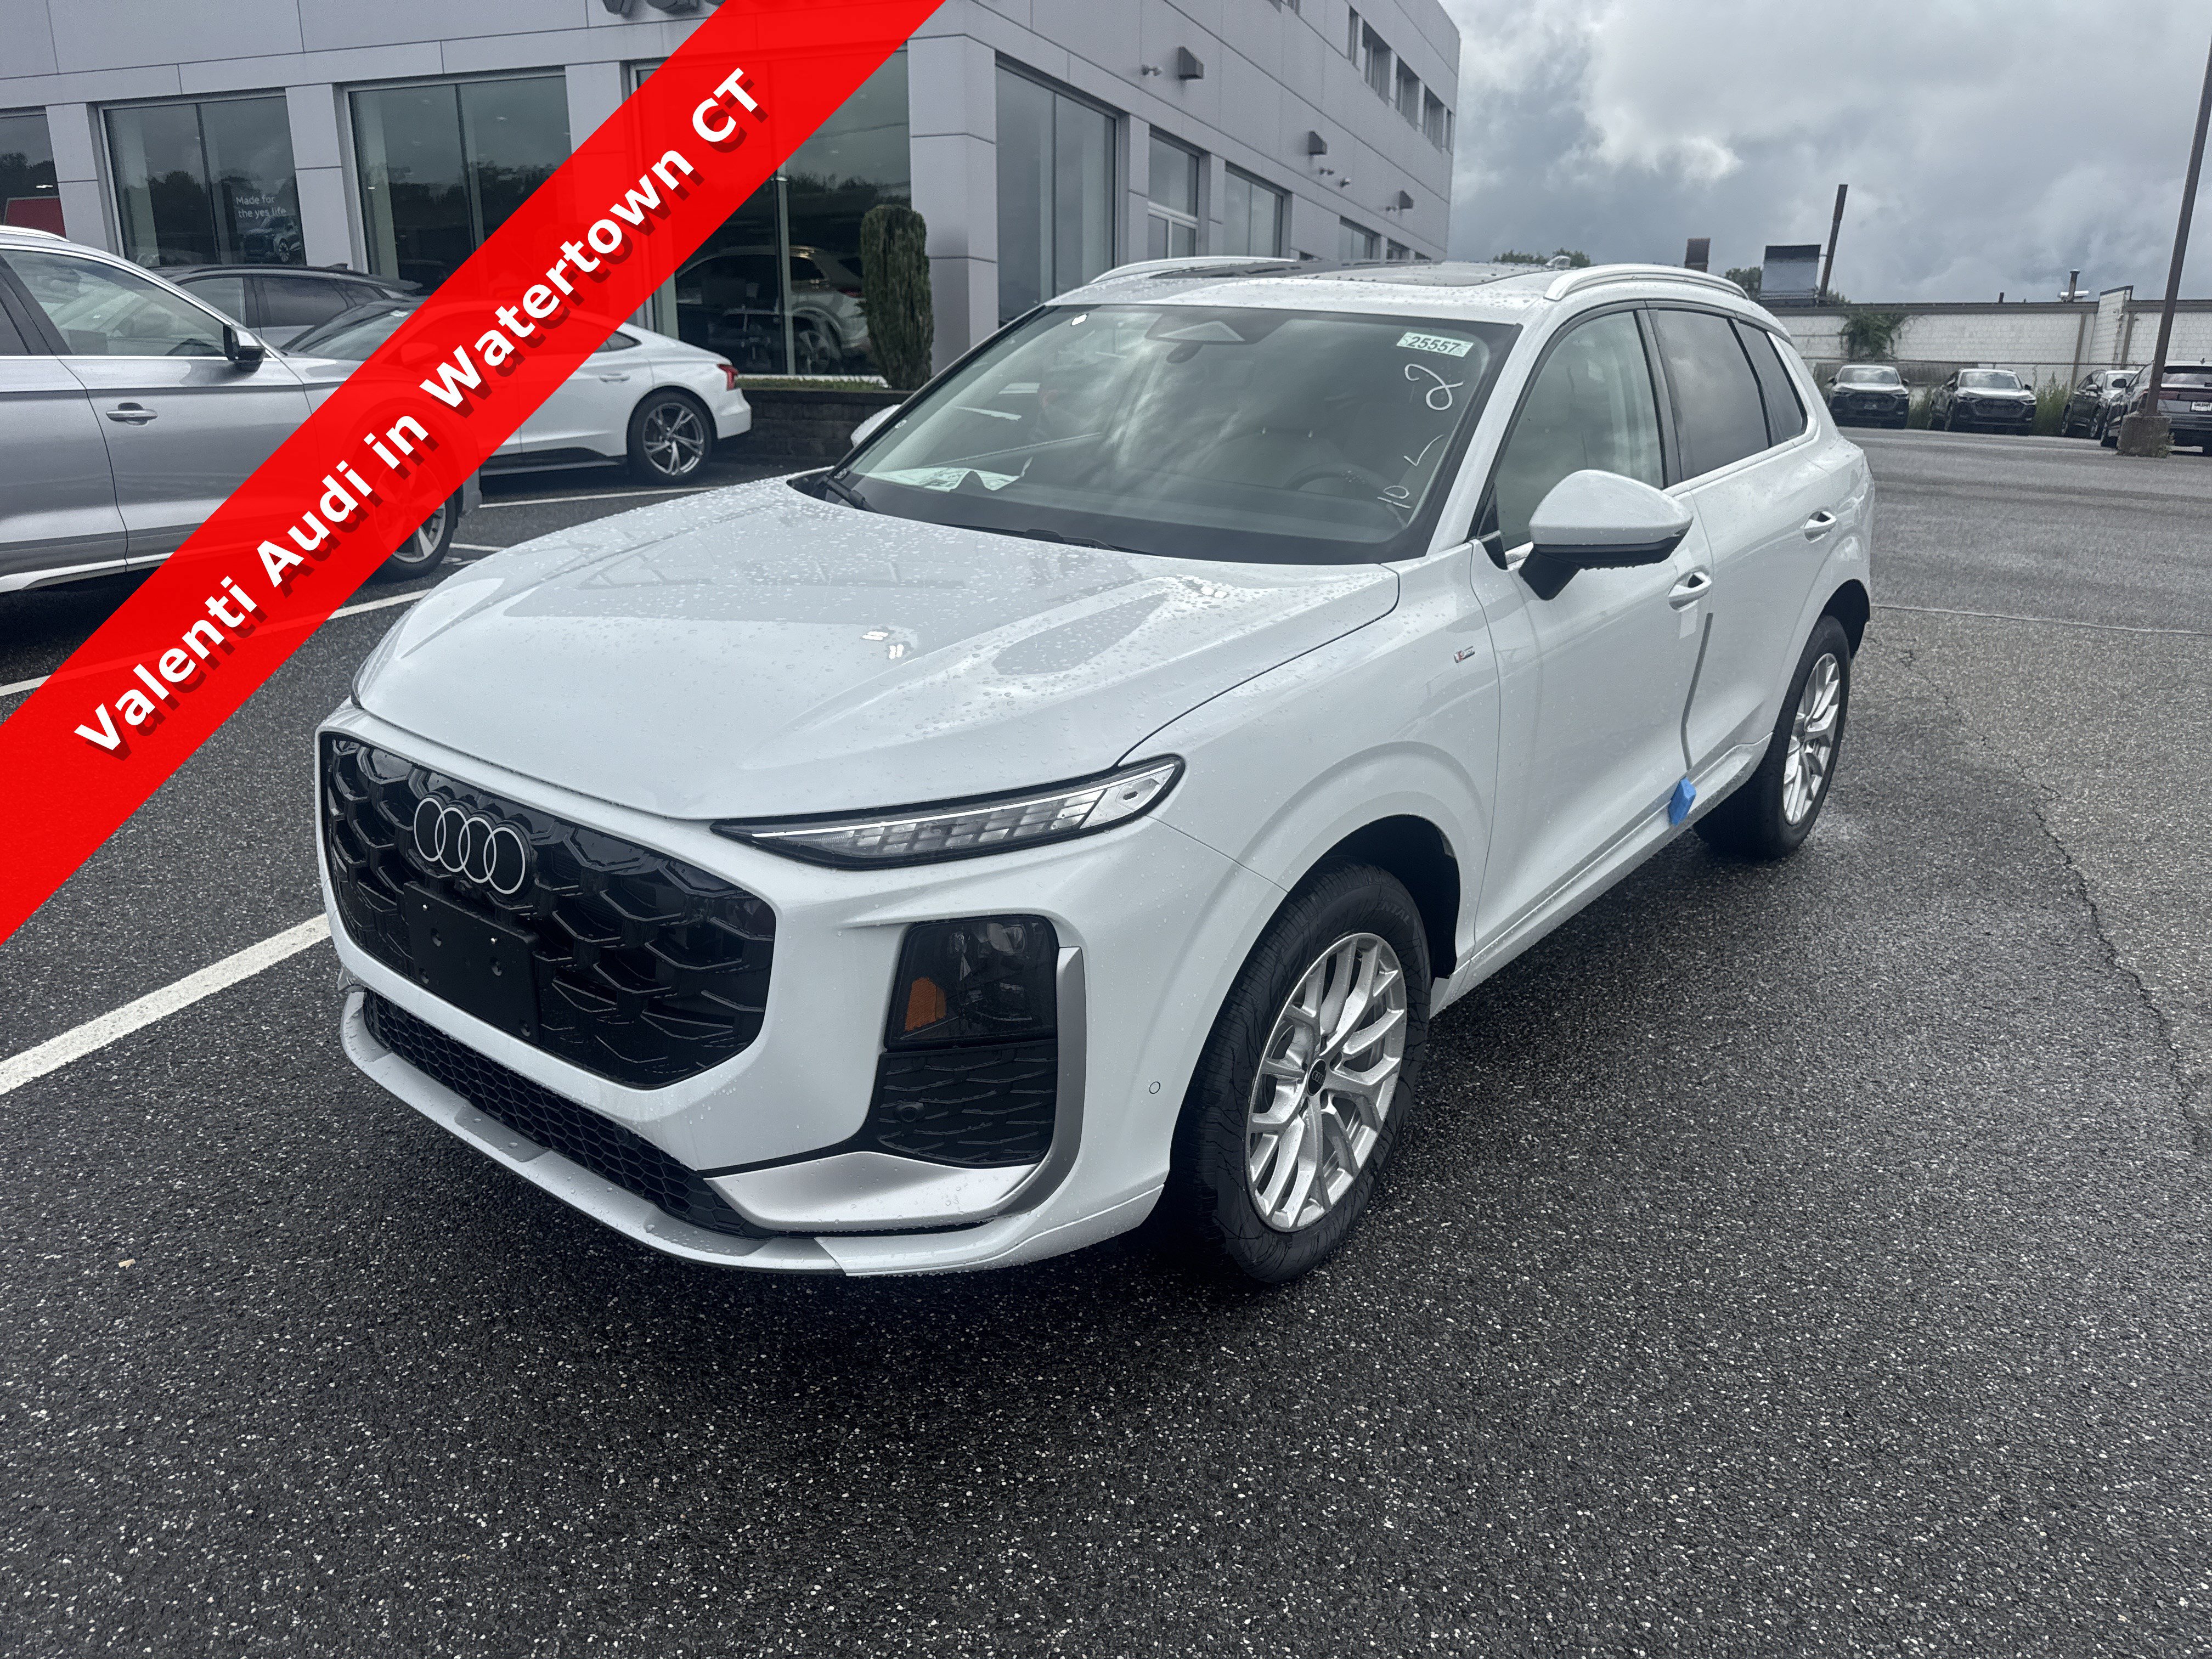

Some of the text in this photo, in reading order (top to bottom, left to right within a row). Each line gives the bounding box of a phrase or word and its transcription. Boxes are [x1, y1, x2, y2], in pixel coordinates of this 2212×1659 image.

[235, 195, 275, 205] Made for
[238, 206, 286, 219] the yes life
[1407, 336, 1462, 353] 25557
